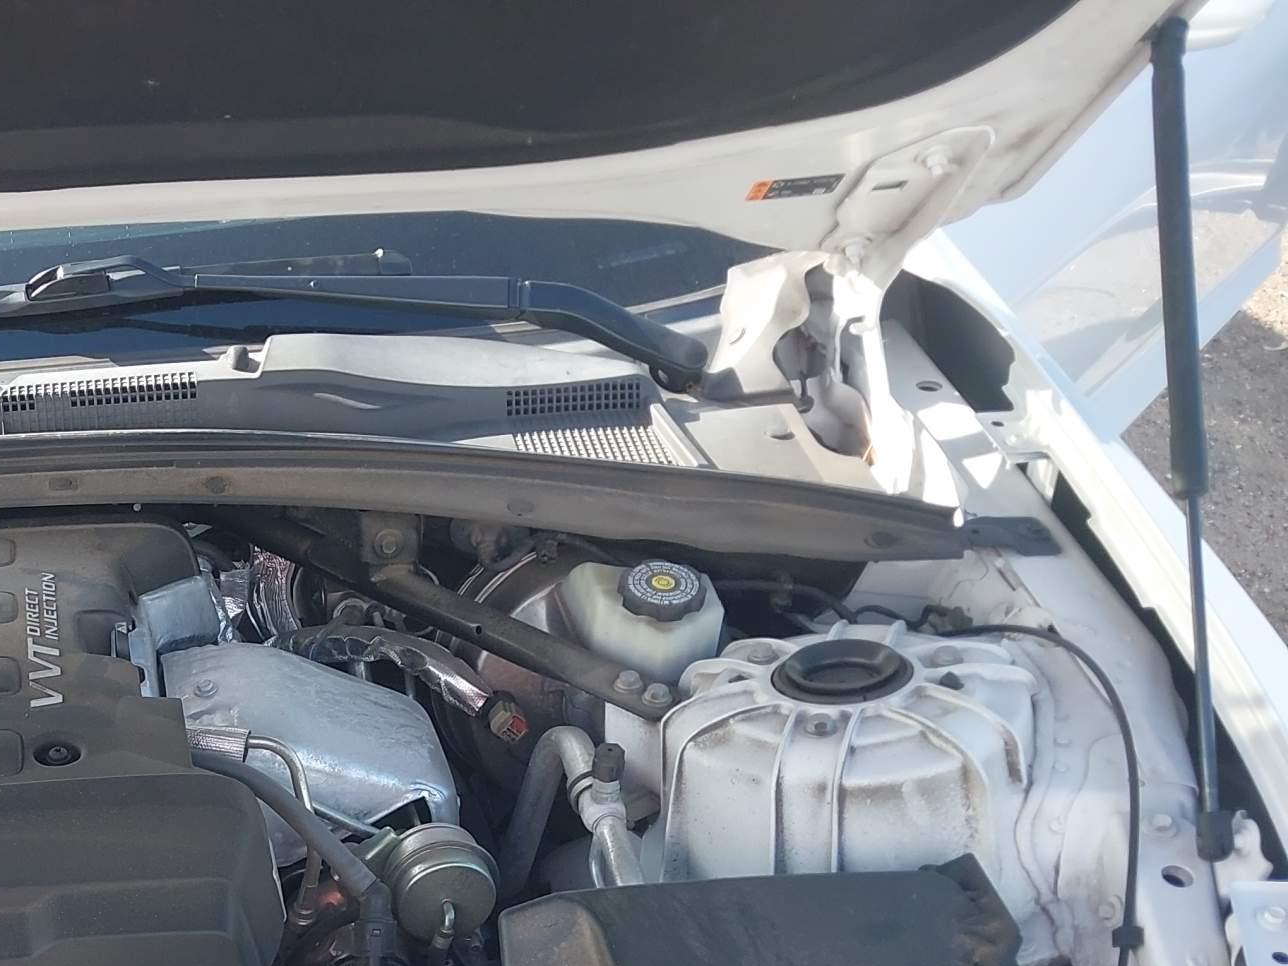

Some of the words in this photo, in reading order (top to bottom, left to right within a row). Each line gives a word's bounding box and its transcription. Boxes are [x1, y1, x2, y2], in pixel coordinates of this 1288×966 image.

[25, 587, 41, 636] DIRECT
[41, 572, 59, 640] INJECTION
[27, 637, 63, 708] VVT
